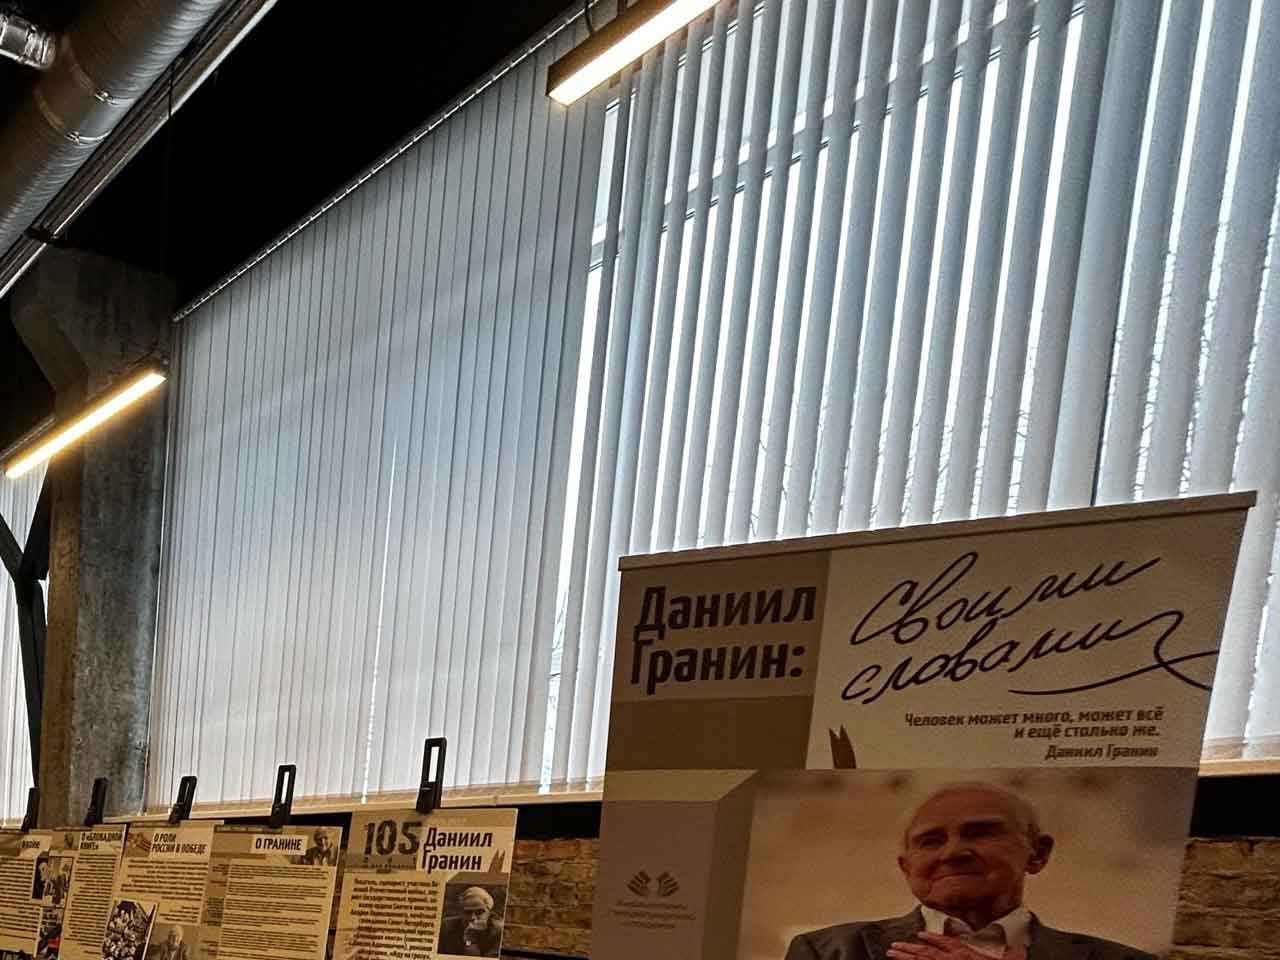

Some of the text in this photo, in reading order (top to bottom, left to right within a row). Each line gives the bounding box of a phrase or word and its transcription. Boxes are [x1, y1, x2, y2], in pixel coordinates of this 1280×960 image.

[850, 551, 1161, 645] Своими
[633, 586, 817, 641] Даниил
[630, 638, 806, 695] Гранин:
[905, 712, 965, 728] Человек
[967, 712, 1018, 726] может
[1078, 709, 1132, 723] может
[1014, 727, 1024, 739] и
[1045, 743, 1159, 761] Даниил Гранин
[255, 836, 303, 851] О ГРАНИНЕ
[363, 819, 422, 856] 105
[423, 827, 493, 849] Даниил
[421, 849, 483, 875] Гранин
